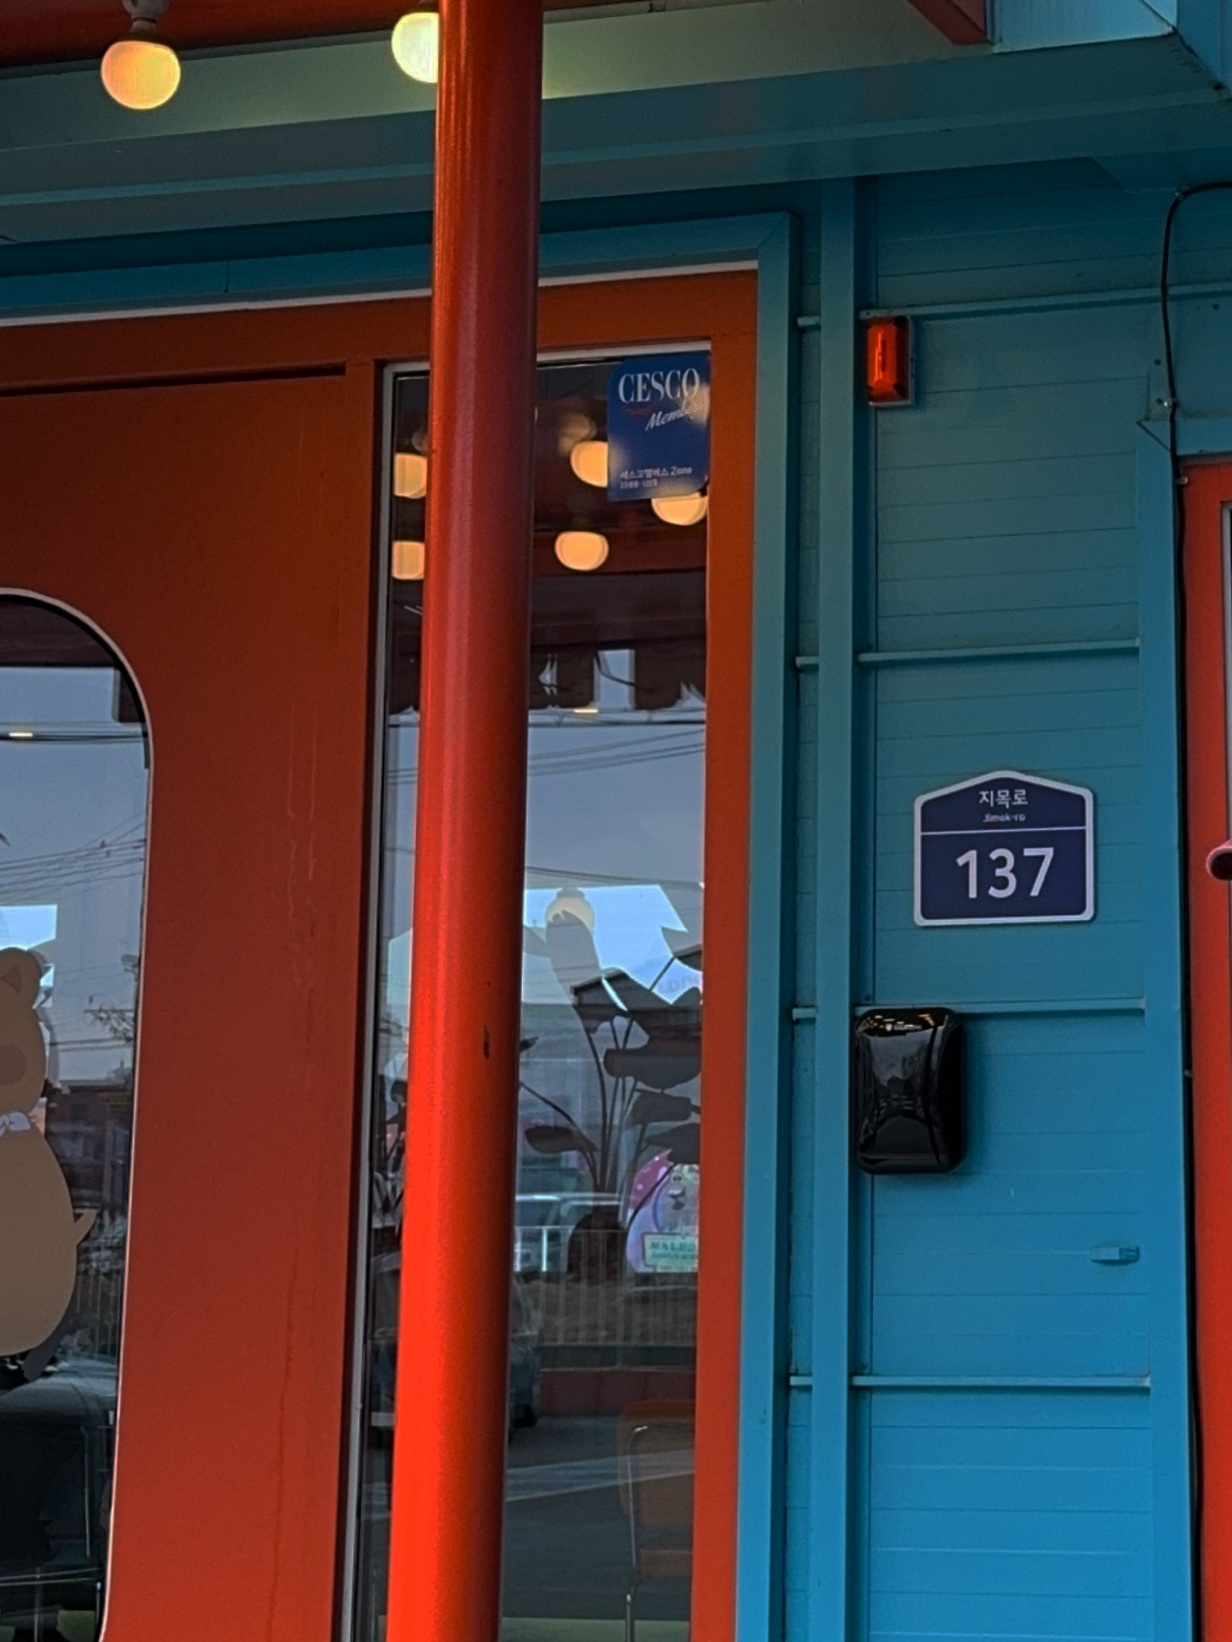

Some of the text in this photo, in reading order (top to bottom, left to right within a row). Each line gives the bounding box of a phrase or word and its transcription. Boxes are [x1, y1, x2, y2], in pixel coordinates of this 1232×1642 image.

[618, 368, 700, 403] CESCO
[670, 466, 693, 476] Zone
[978, 789, 1028, 808] 지목로
[955, 847, 1054, 899] 137
